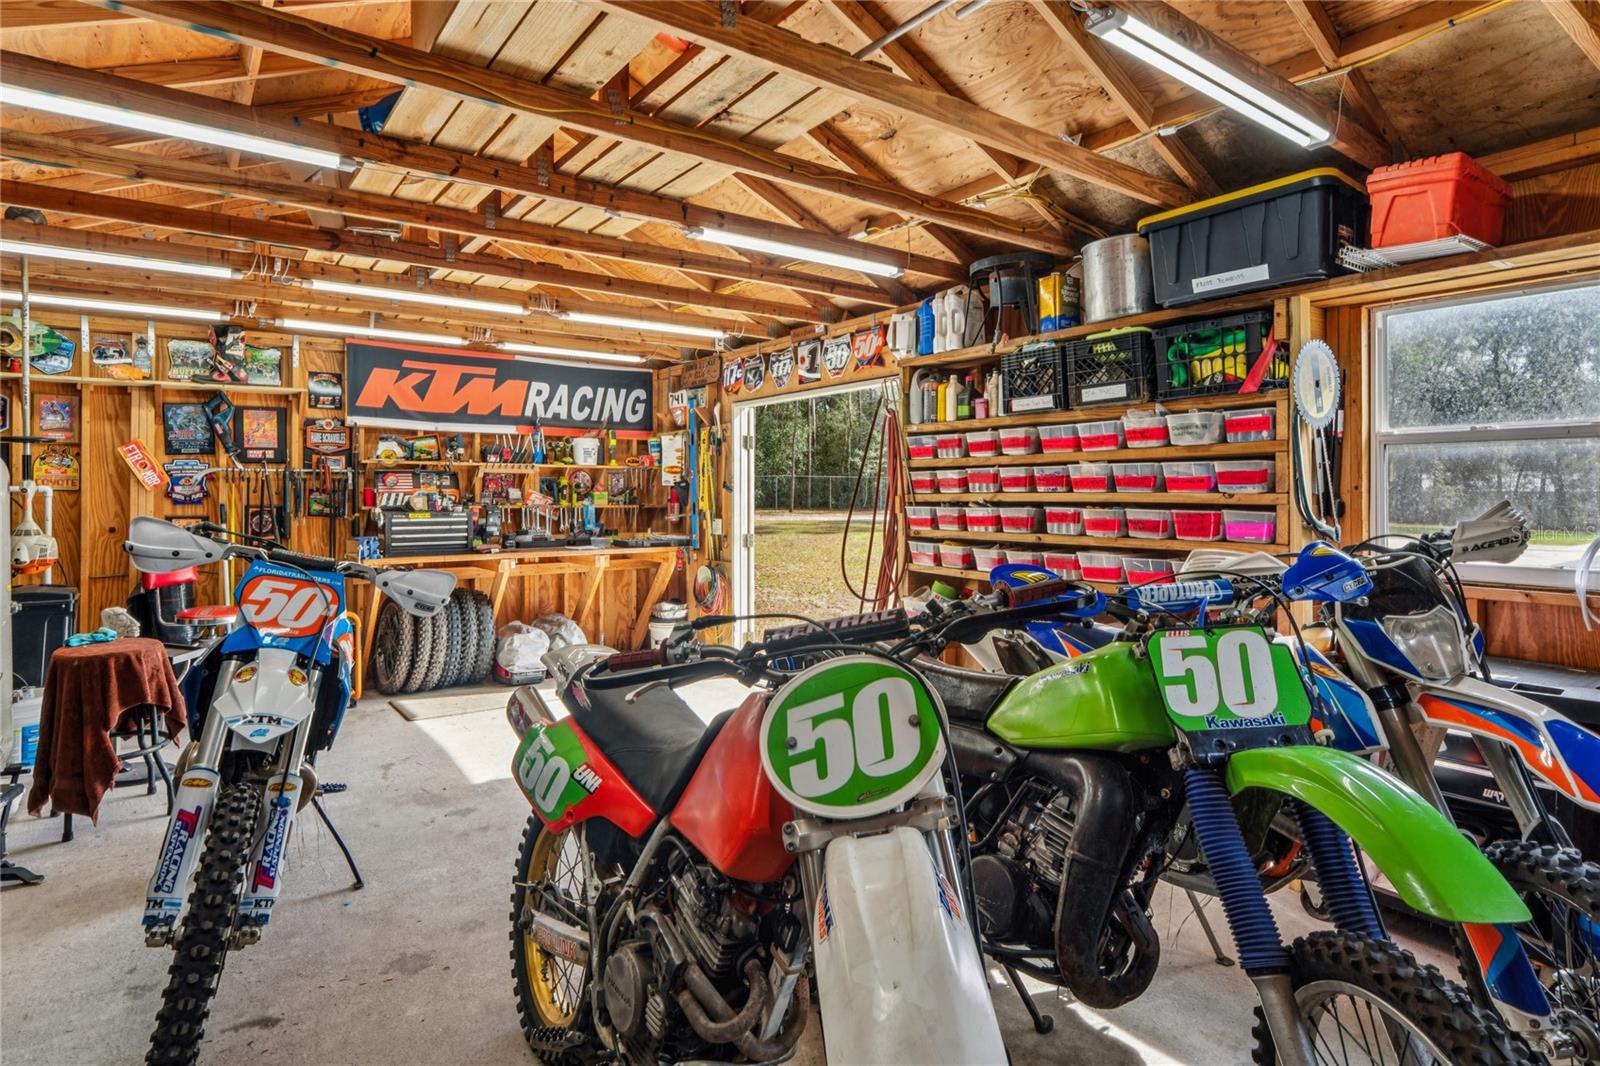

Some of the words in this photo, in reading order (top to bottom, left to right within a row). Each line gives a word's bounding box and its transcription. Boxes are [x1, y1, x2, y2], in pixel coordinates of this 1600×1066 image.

[355, 360, 528, 416] KTM
[525, 382, 647, 424] RACING
[669, 393, 684, 404] 741
[1165, 630, 1190, 638] ELLIS
[1160, 630, 1278, 719] 50
[787, 677, 921, 798] 50
[1206, 712, 1286, 729] Kawasaki
[519, 731, 571, 813] 50
[147, 900, 164, 909] TM
